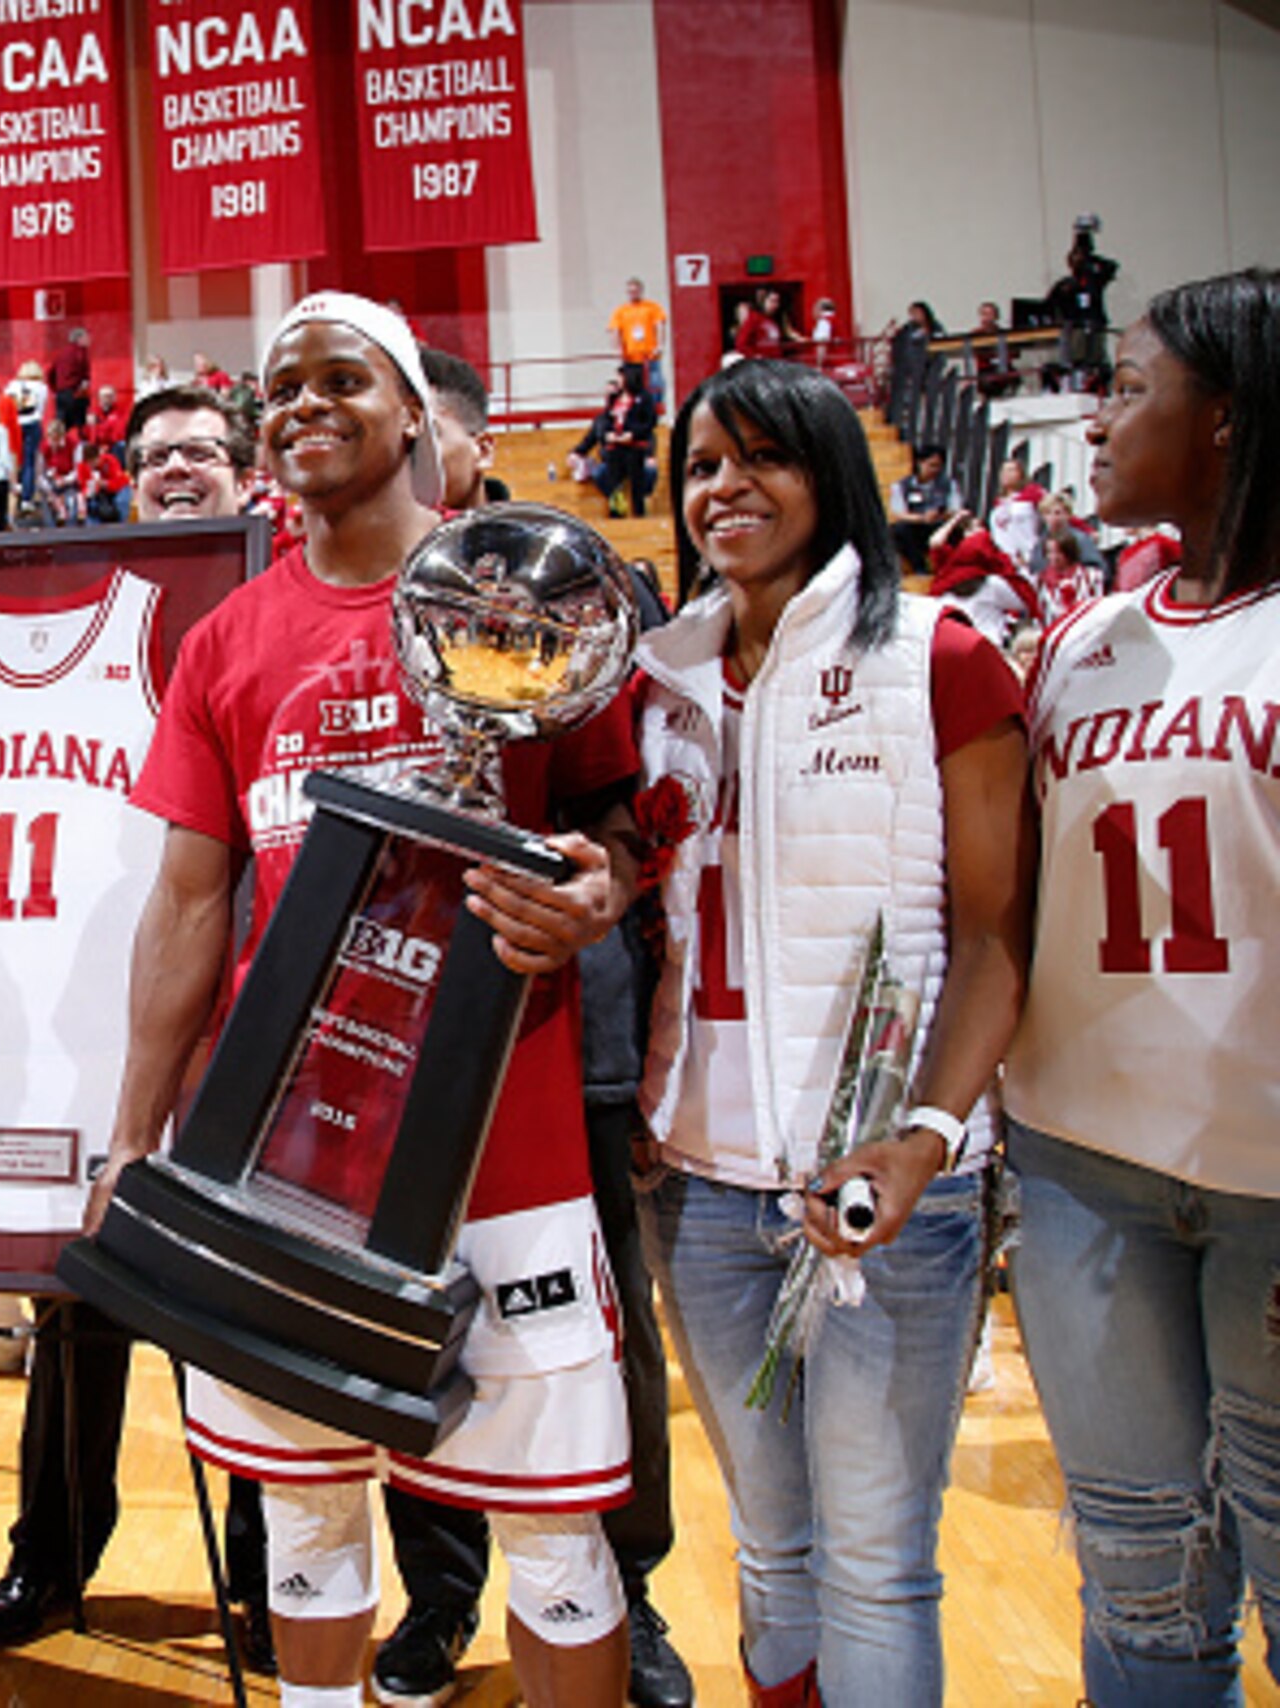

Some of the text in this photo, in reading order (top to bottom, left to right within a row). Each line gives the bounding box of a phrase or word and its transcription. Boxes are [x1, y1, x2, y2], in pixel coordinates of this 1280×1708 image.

[156, 7, 307, 77] NCAA
[358, 0, 516, 50] NCAA
[163, 76, 305, 130] BASKETBALL
[365, 56, 515, 105] BASKETBALL
[171, 121, 302, 171] CHAMPIONS
[374, 102, 512, 149] CHAMPIONS
[211, 181, 266, 218] 1981
[413, 160, 480, 200] 1987
[11, 200, 74, 238] 1976
[686, 259, 706, 282] 7
[800, 747, 881, 775] Mom
[1041, 694, 1280, 799] NDIAN
[1093, 796, 1229, 974] 11
